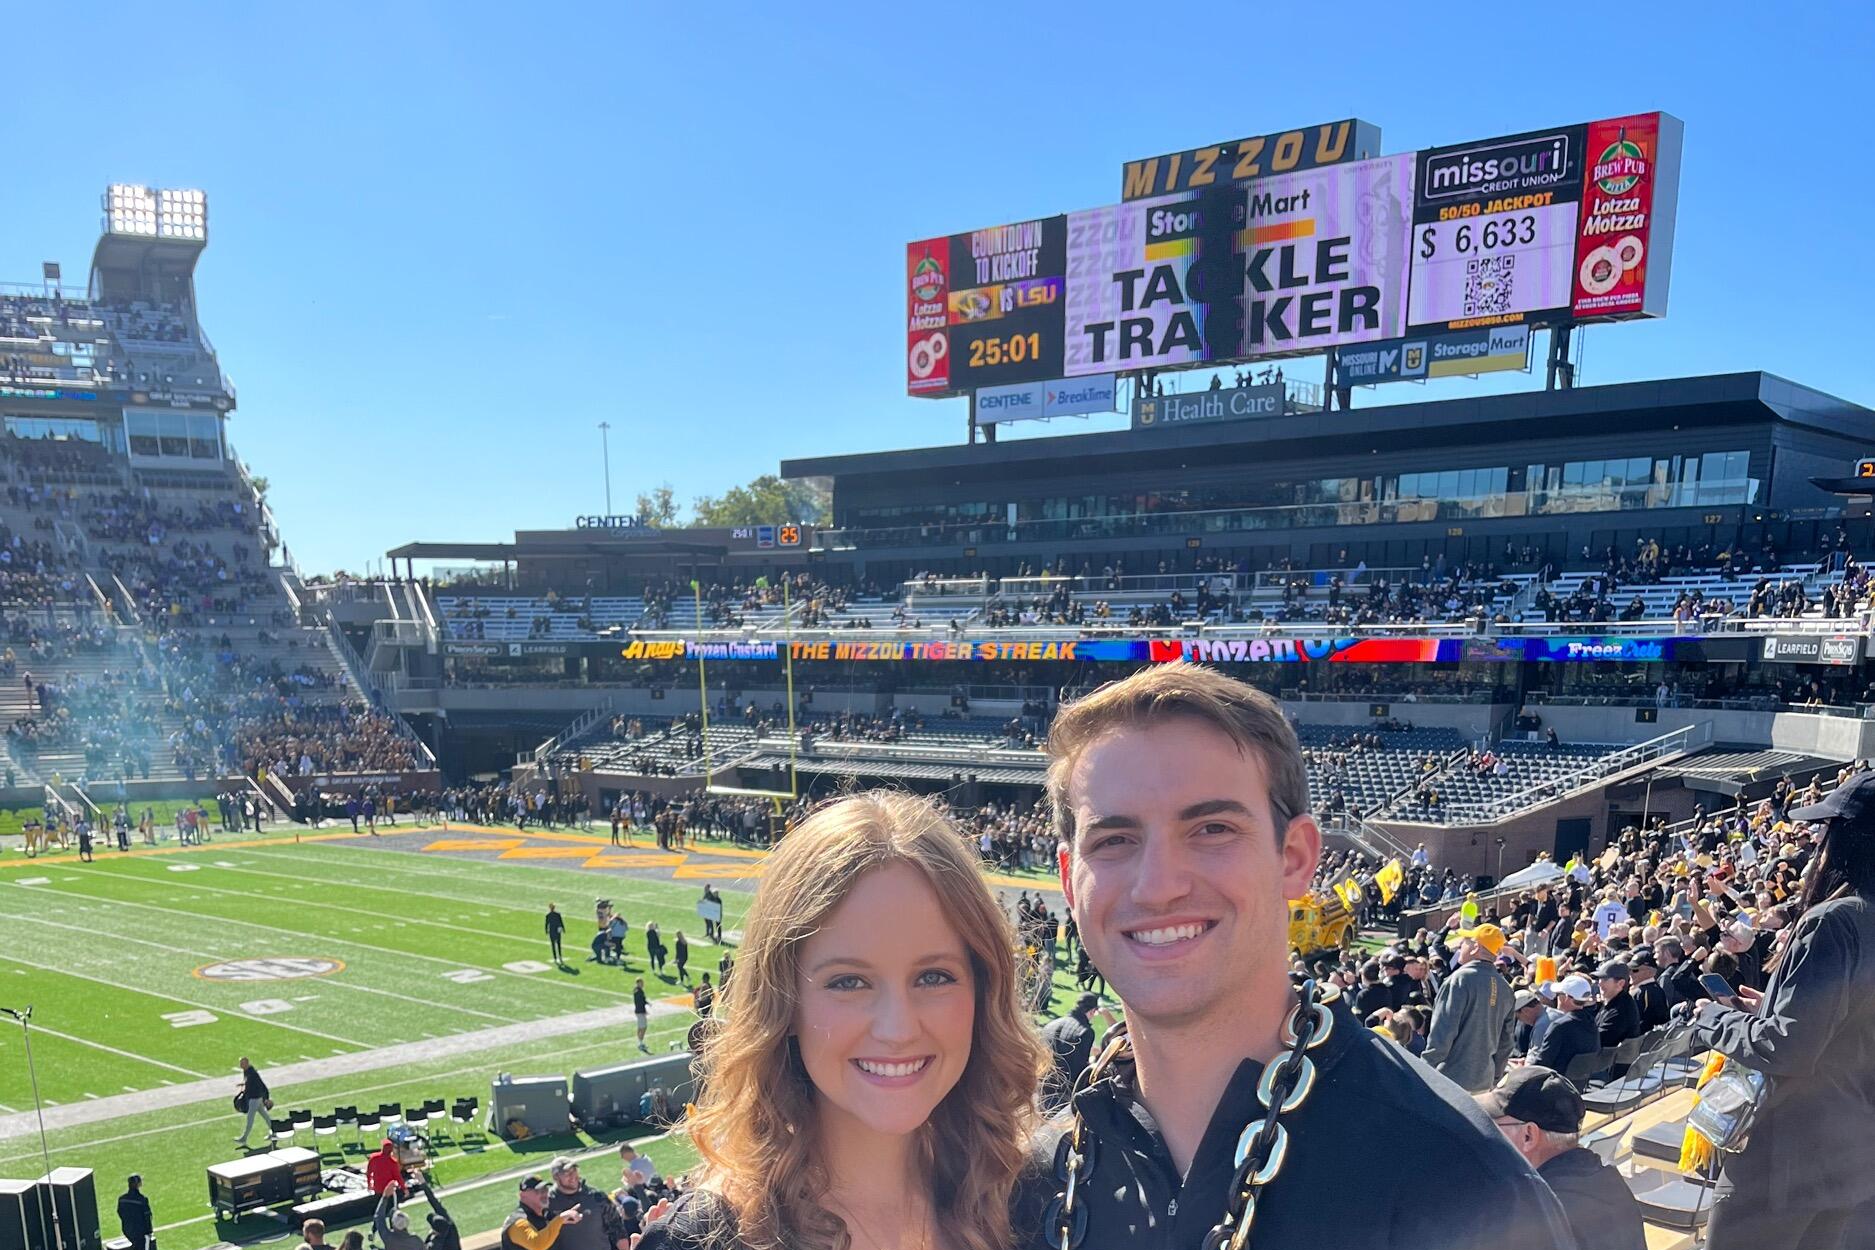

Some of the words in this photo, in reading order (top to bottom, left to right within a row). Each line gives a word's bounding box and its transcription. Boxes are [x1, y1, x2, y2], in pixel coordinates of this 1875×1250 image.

[1124, 121, 1350, 199] MIZZOU
[1433, 141, 1561, 189] missouri
[1593, 160, 1622, 183] BREW
[1624, 156, 1645, 176] PUB
[1481, 179, 1519, 194] CREDIT
[1521, 172, 1559, 188] UNION
[1606, 179, 1631, 193] PIZZA
[1439, 203, 1481, 221] 50/50
[1483, 192, 1553, 215] JACKPOT
[1593, 196, 1641, 216] Lotzza
[1583, 213, 1646, 237] Motzza
[971, 221, 1042, 258] COUNTDOWN
[1421, 224, 1436, 262] $
[1455, 215, 1536, 256] 6,633
[975, 258, 990, 284] TO
[992, 249, 1039, 283] KICKOFF
[1000, 287, 1014, 313] VS
[1017, 284, 1057, 309] LSU
[969, 332, 1040, 368] 25:01
[1341, 351, 1378, 366] MISSOURI
[1350, 363, 1376, 377] ONLINE
[980, 391, 1032, 410] CENTENE
[1162, 394, 1224, 422] Health
[1230, 392, 1276, 415] Care
[1704, 514, 1722, 524] 127
[781, 527, 798, 545] 25
[523, 645, 566, 654] LEARFIELD
[686, 641, 727, 660] Frozen
[729, 640, 779, 660] Custard
[791, 641, 829, 660] THE
[835, 641, 904, 660] MIZZOU
[911, 641, 973, 660] TIGER
[979, 641, 1077, 660] STREAK
[1777, 643, 1818, 655] LEARFIELD
[1607, 912, 1617, 923] 9
